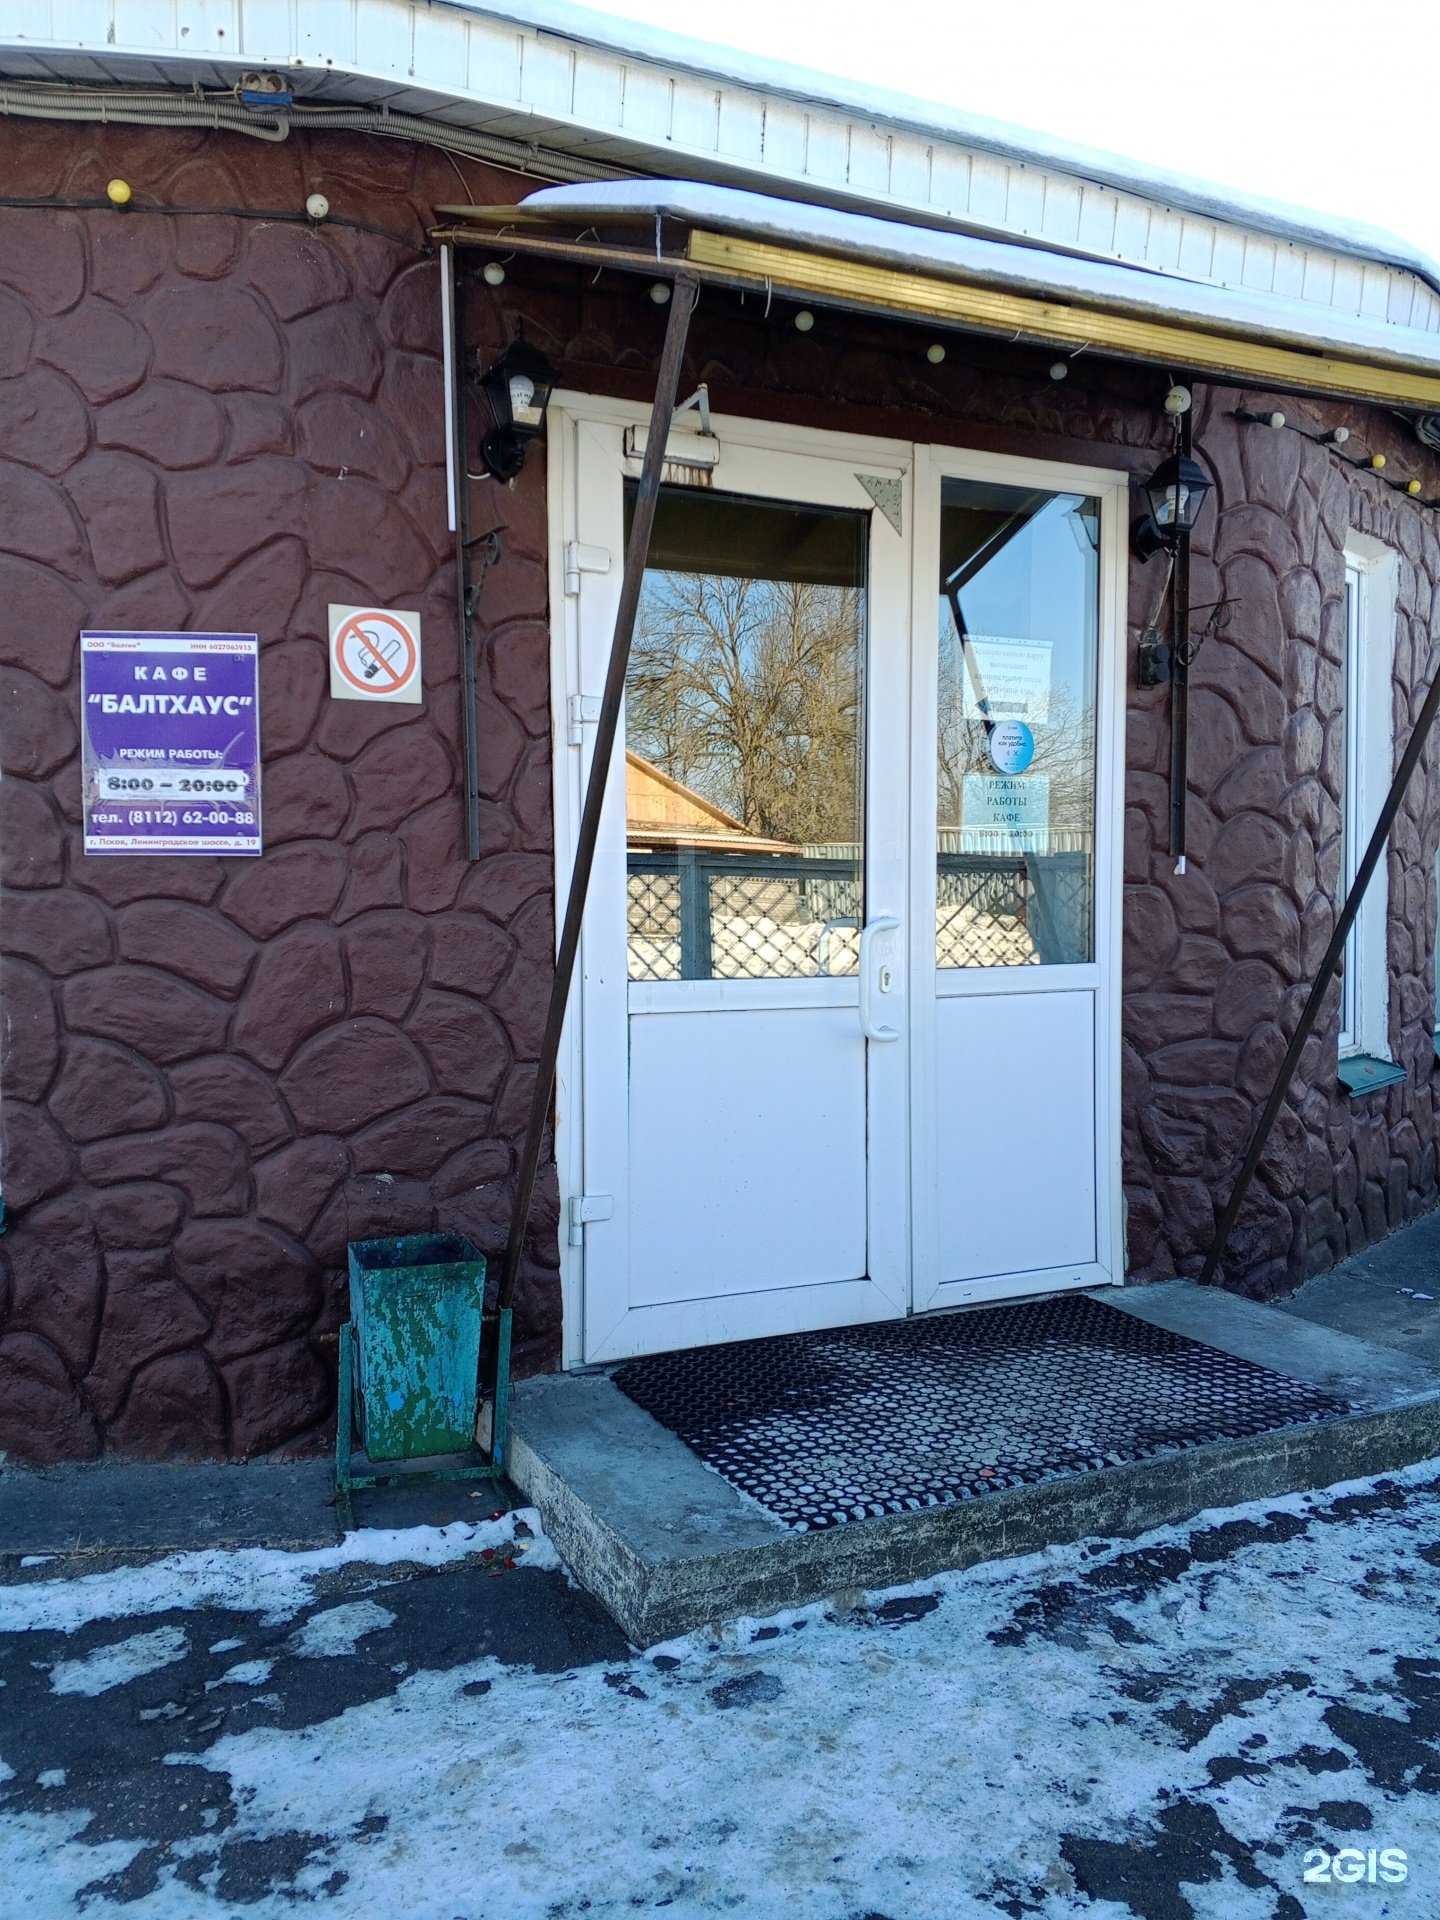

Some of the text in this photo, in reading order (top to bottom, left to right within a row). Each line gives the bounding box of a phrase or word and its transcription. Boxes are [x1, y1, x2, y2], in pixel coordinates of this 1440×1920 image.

[134, 666, 207, 681] КАФЕ
[119, 749, 223, 760] РЕЖИМ РАБОТЫ:
[107, 777, 154, 790] 8:00
[988, 780, 1025, 790] РЕЖИМ
[986, 796, 1027, 806] РАБОТЫ
[91, 811, 254, 826] тел. (8112) 62-00-88
[993, 812, 1020, 822] КАФЕ
